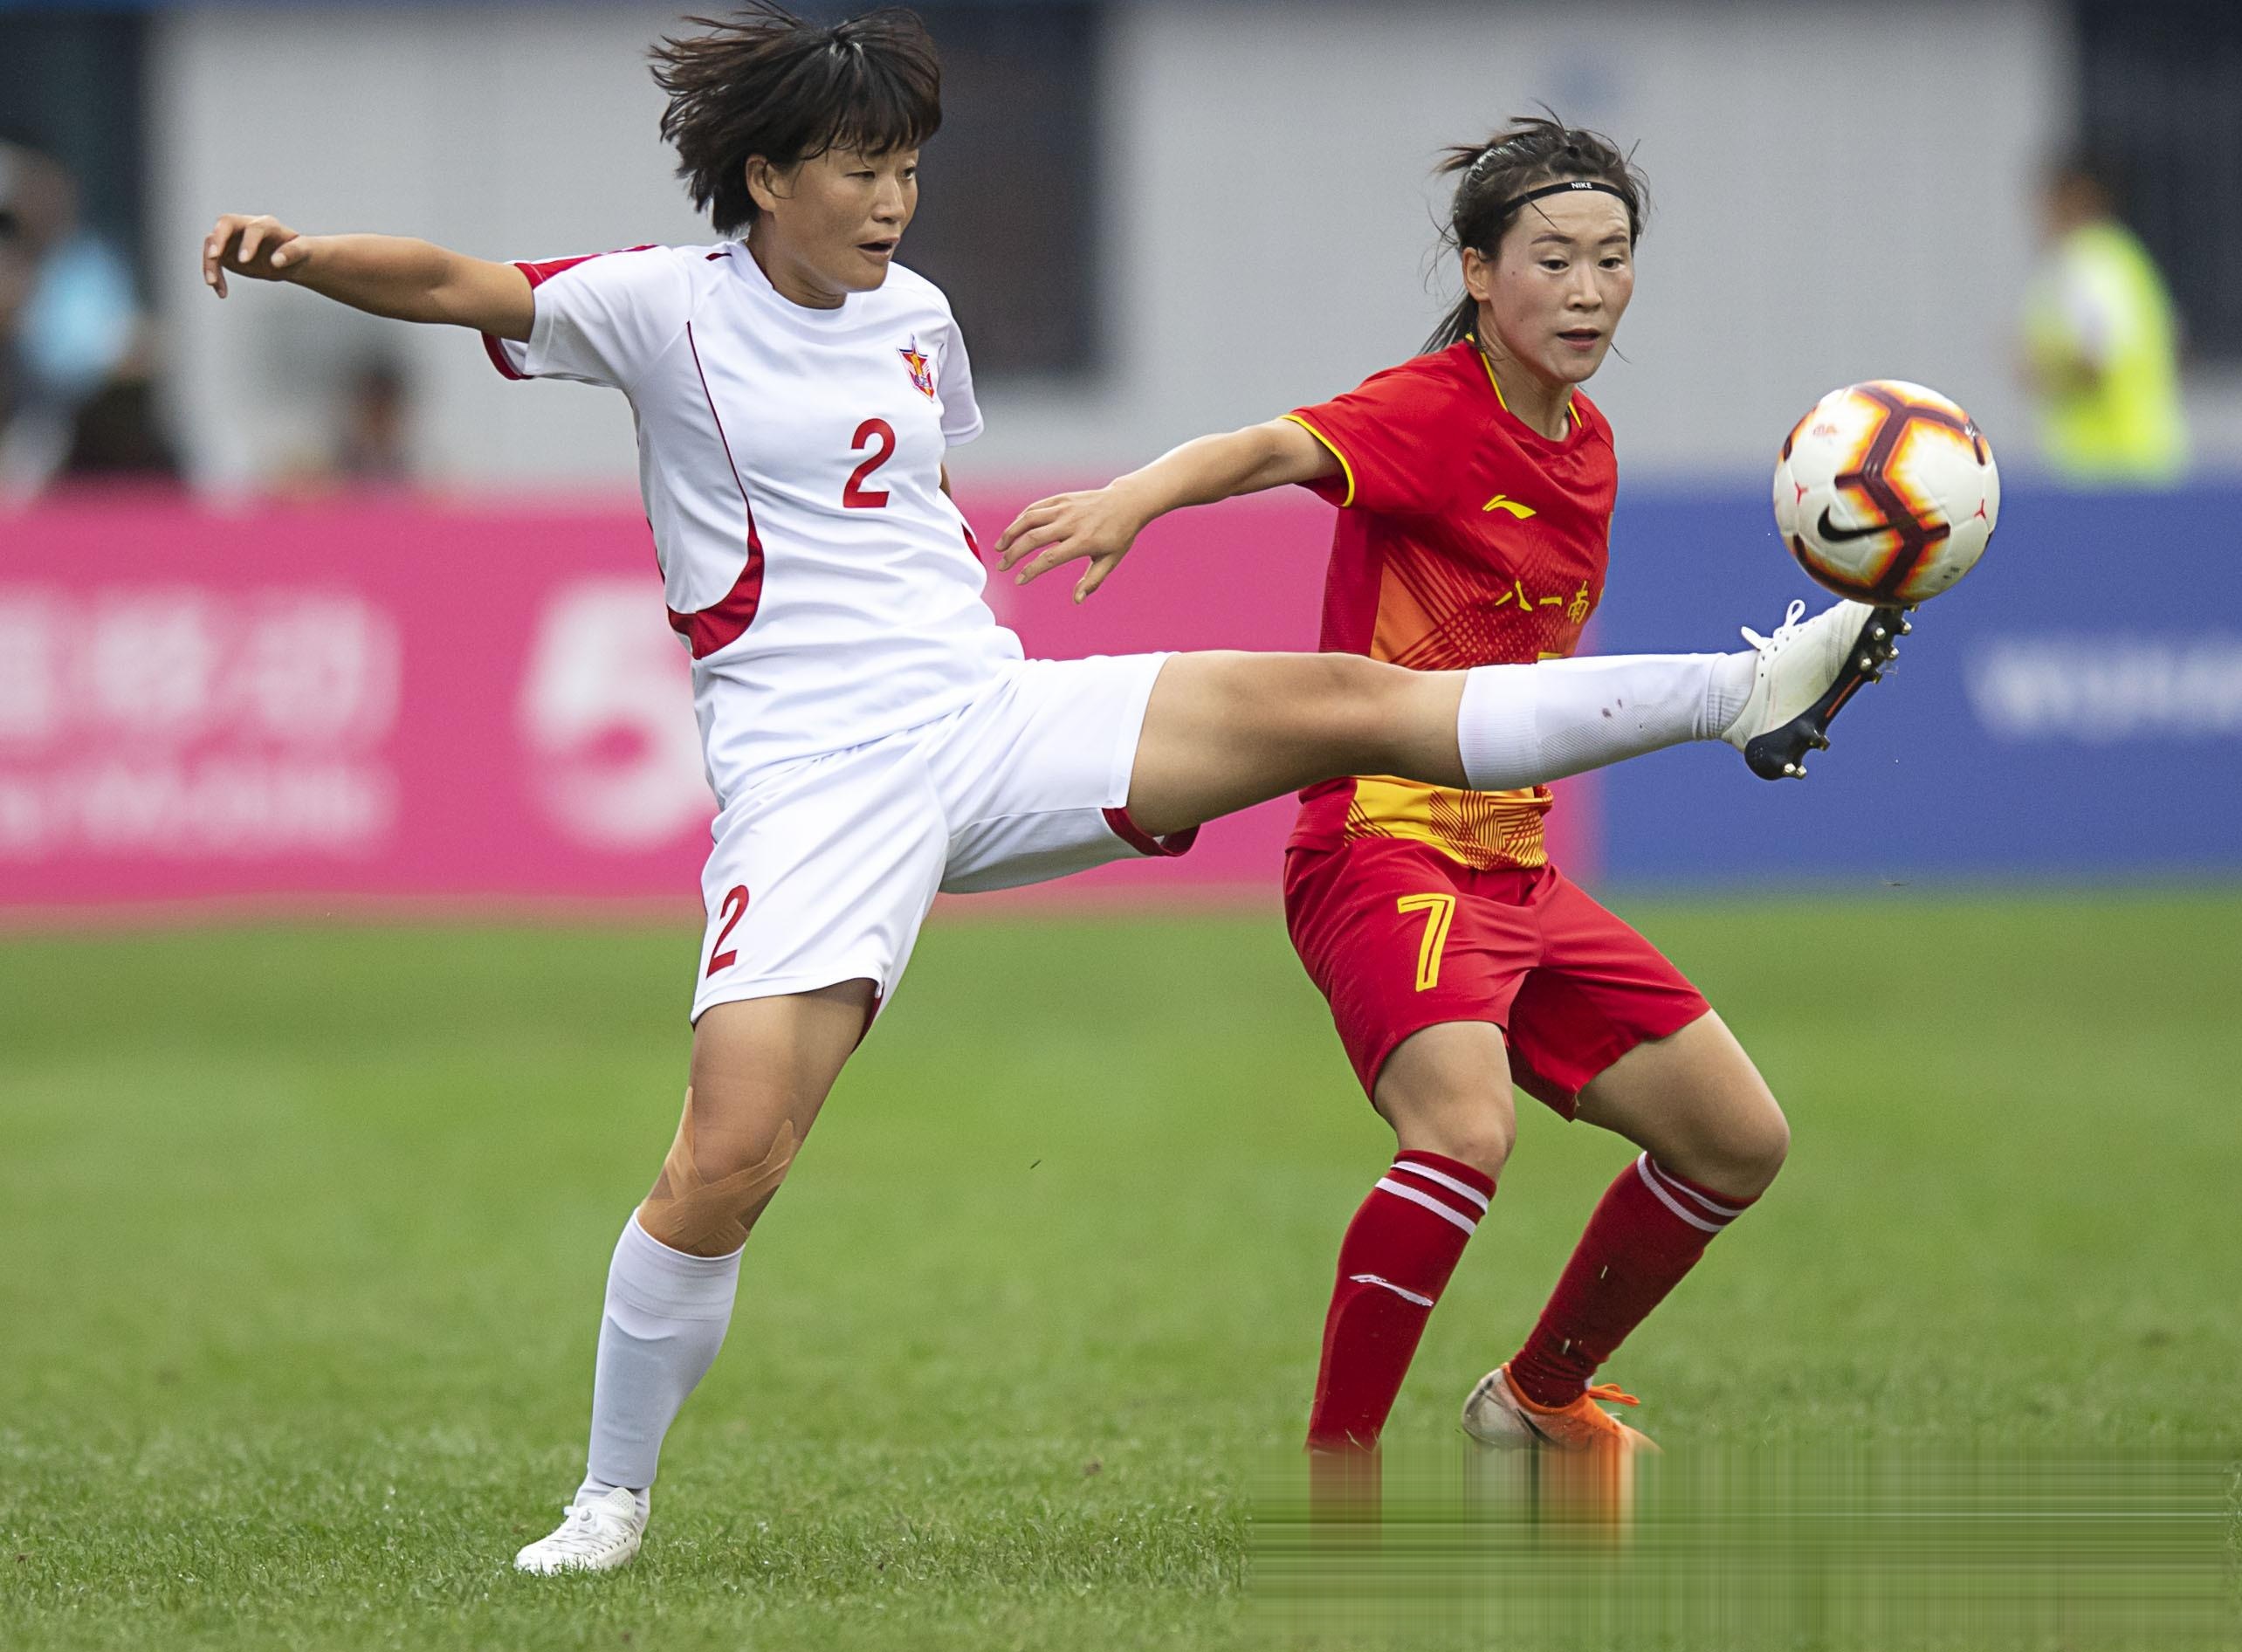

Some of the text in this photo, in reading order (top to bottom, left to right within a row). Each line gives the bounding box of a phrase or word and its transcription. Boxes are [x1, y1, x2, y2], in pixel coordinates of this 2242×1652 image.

[842, 417, 896, 508] 2
[705, 885, 749, 980] 2
[1397, 893, 1456, 993] 7
